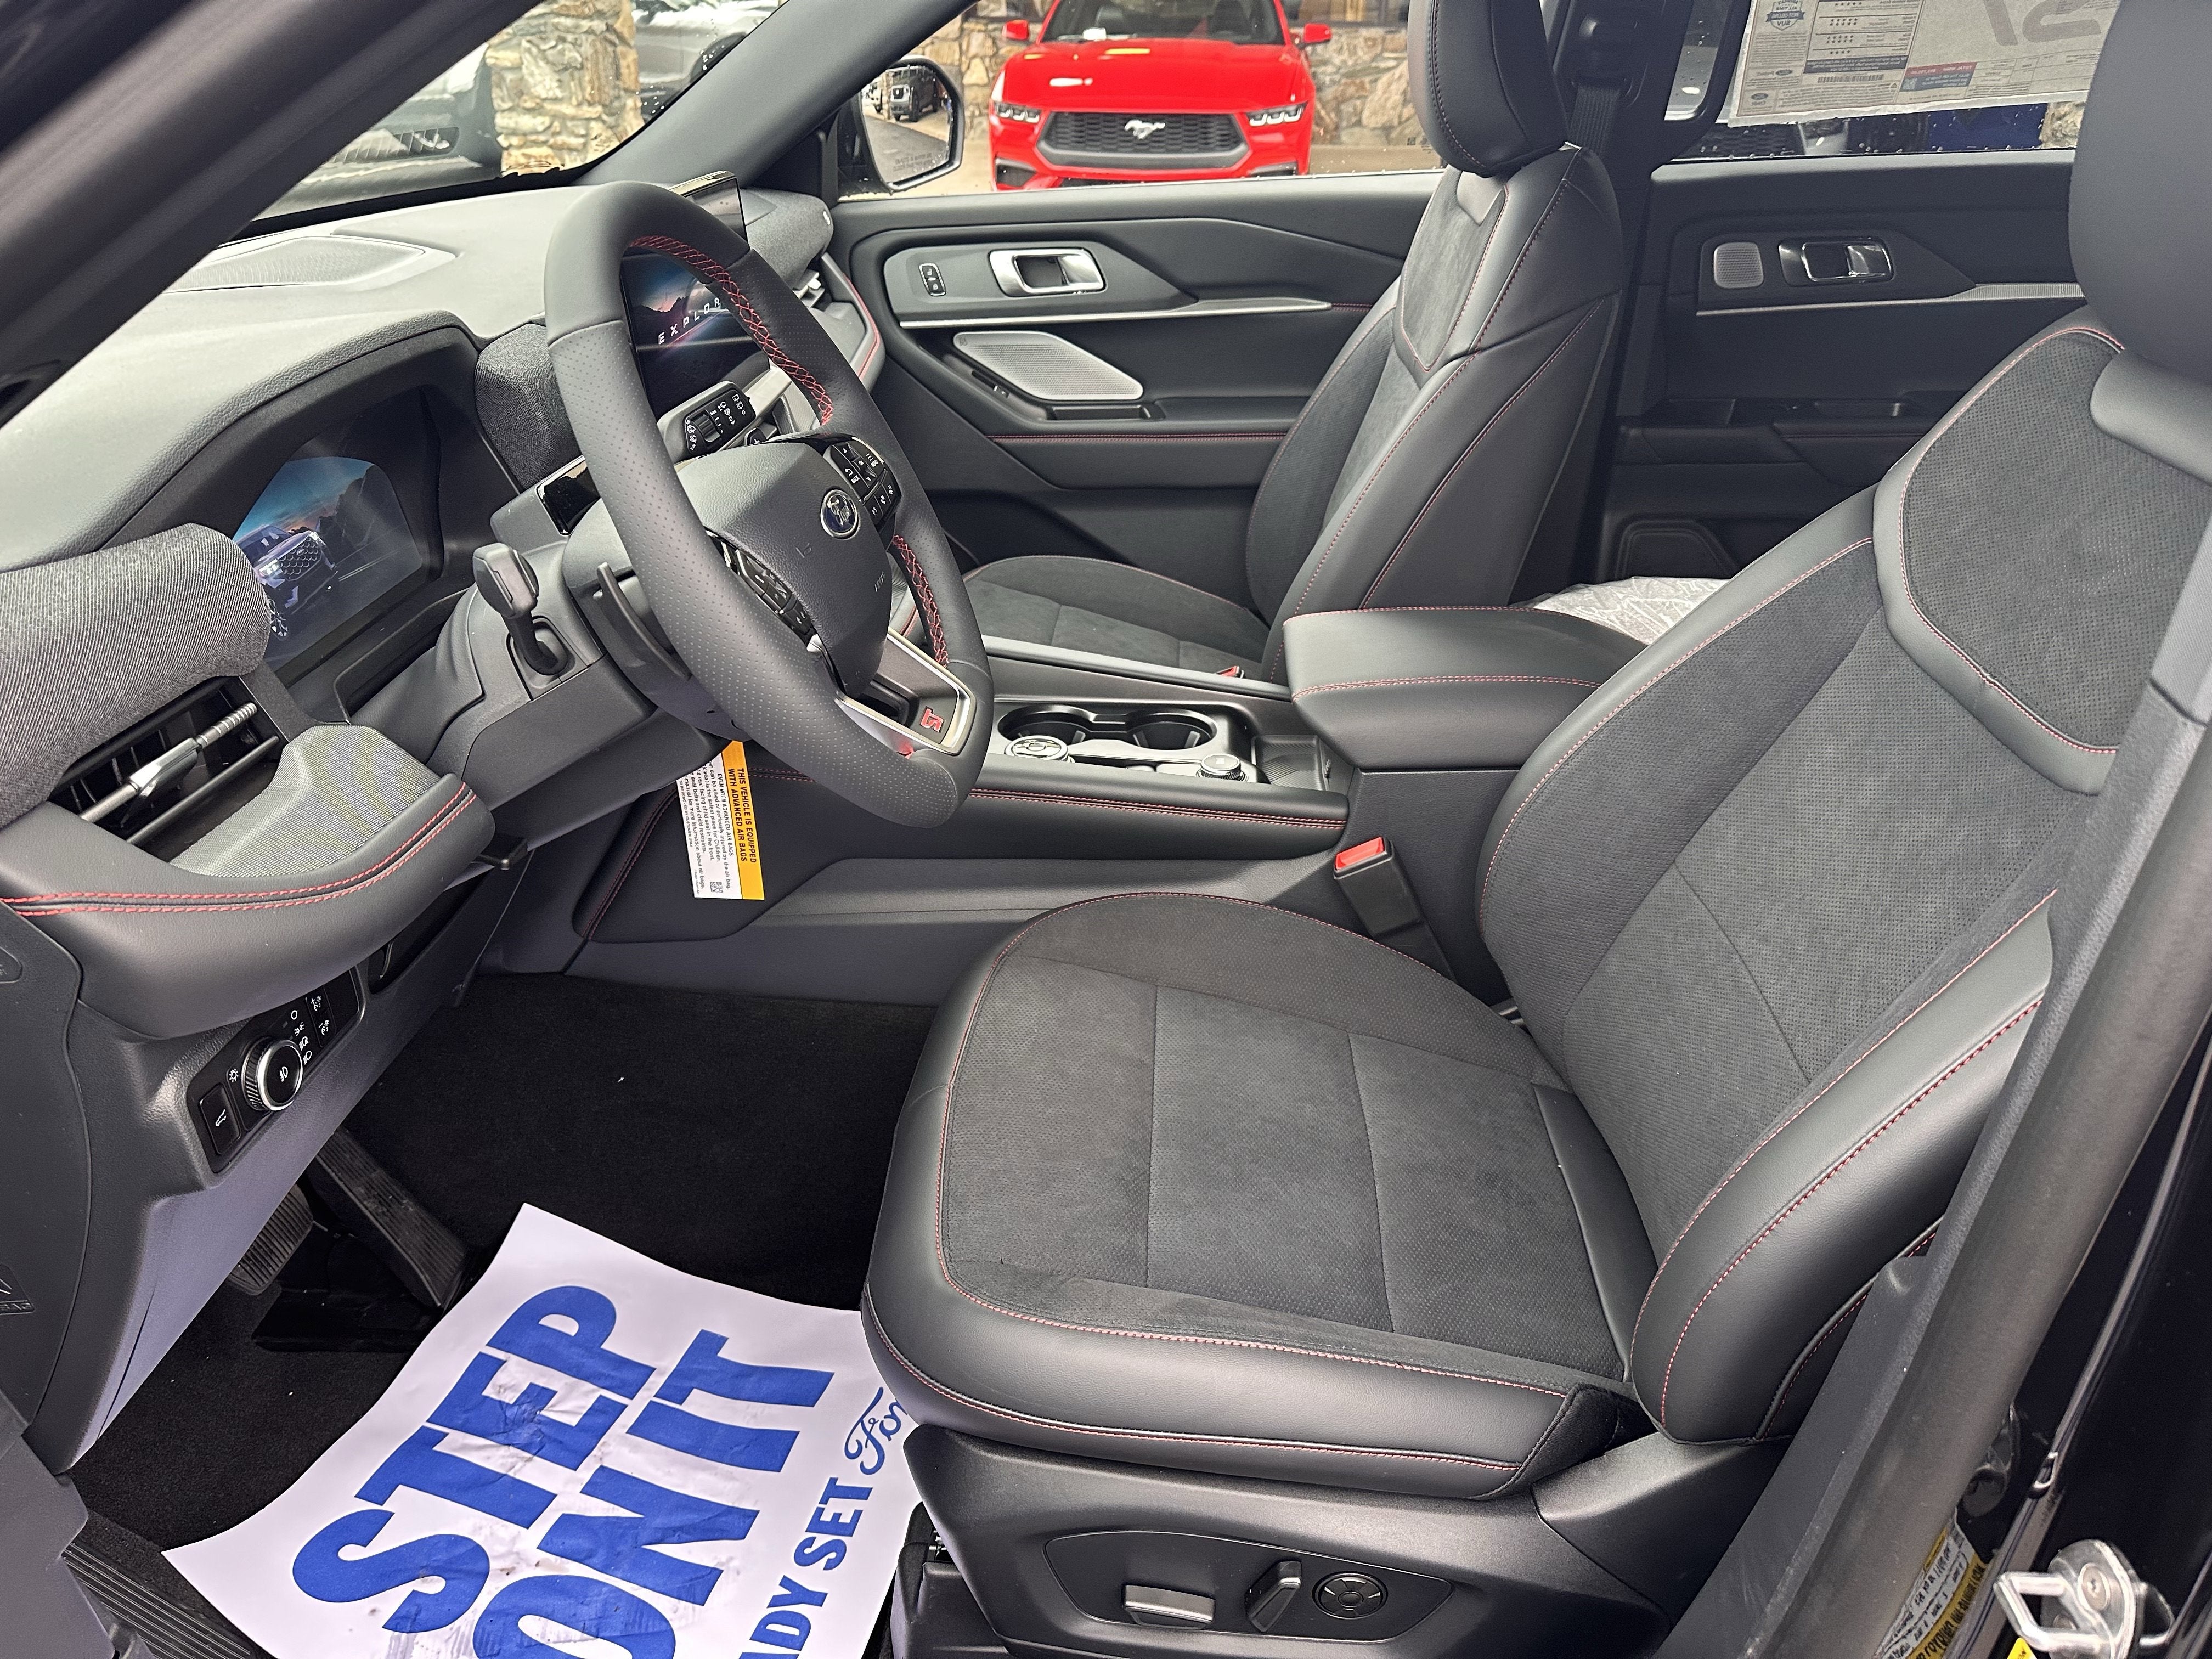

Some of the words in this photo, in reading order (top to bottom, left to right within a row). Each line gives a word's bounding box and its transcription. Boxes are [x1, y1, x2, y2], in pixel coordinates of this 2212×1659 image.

[728, 769, 736, 786] WITH
[737, 768, 746, 783] THIS
[731, 789, 742, 826] ADVANCED
[740, 786, 751, 816] VEHICLE
[715, 810, 724, 833] seriously
[722, 803, 730, 830] ADVANCED
[692, 822, 700, 850] information
[745, 827, 757, 862] EQUIPPED
[738, 843, 747, 861] BAGS
[292, 1286, 657, 1633] STEP
[473, 1464, 760, 1659] ON
[626, 1329, 836, 1472] IT
[794, 1477, 873, 1570] SET
